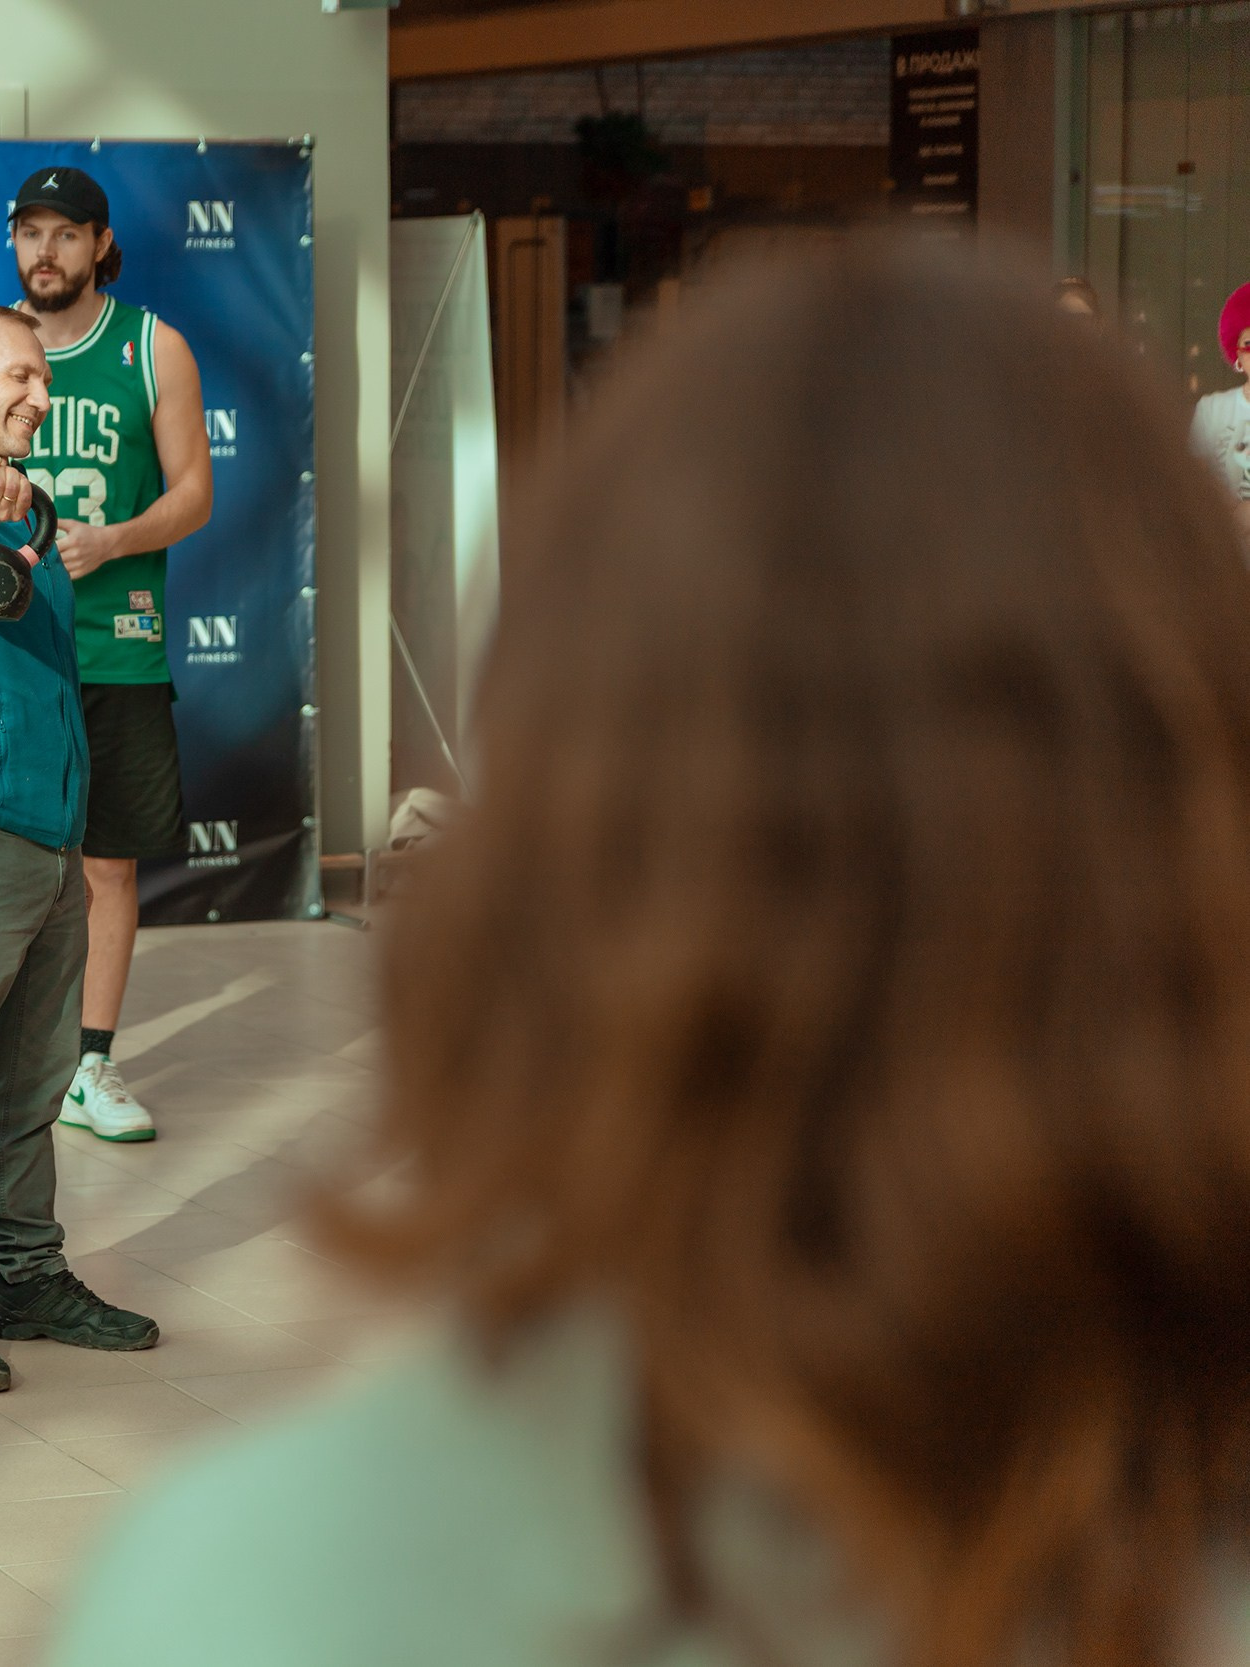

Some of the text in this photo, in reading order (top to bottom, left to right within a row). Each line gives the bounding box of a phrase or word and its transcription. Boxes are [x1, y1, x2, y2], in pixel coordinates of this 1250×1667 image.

[187, 200, 235, 233] NN
[185, 237, 236, 249] FITNESS
[14, 395, 121, 464] LTICS
[188, 615, 237, 648] NN
[187, 652, 238, 664] FITNESS
[189, 820, 238, 852] NN
[188, 856, 240, 868] FITNESS
